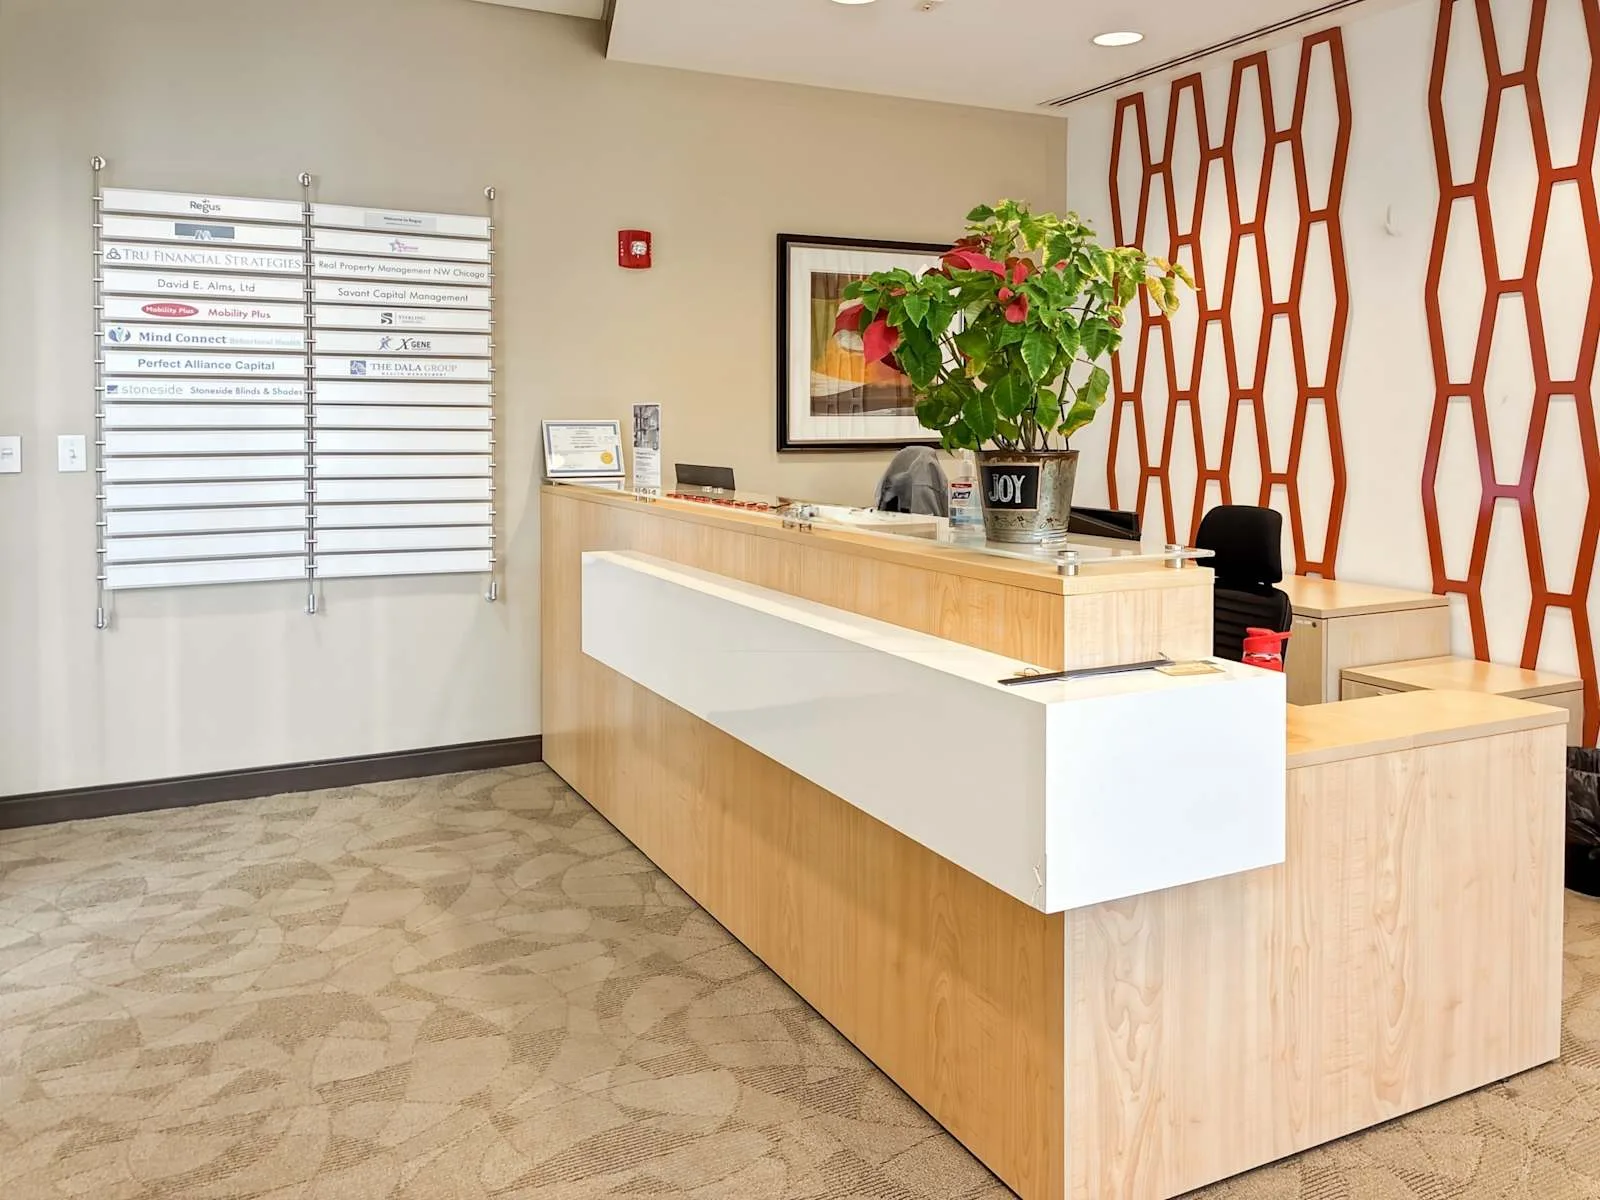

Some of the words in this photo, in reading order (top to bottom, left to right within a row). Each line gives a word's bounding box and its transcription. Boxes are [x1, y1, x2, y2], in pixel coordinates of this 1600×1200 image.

[190, 201, 220, 213] Regus
[122, 248, 149, 260] TRU
[154, 250, 221, 265] FINANCIAL
[224, 254, 300, 269] STRATEGIES
[340, 262, 375, 272] Property
[378, 264, 430, 275] Management
[434, 267, 450, 275] NW
[453, 269, 485, 279] Chicago
[158, 279, 188, 289] David
[193, 281, 202, 289] E.
[208, 282, 235, 292] Alms,
[240, 283, 255, 292] Ltd
[338, 288, 369, 297] Savant
[373, 289, 406, 300] Capital
[410, 291, 468, 302] Management
[146, 305, 176, 314] Mobility
[208, 308, 248, 319] Mobility
[252, 310, 271, 319] Plus
[139, 332, 171, 342] Mind
[176, 333, 227, 344] Connect
[138, 358, 181, 369] Perfect
[184, 360, 232, 370] Alliance
[235, 361, 275, 372] Capital
[424, 364, 457, 372] GROUP
[122, 384, 183, 394] stoneside
[190, 386, 232, 395] Stoneside
[236, 386, 261, 395] Blinds
[272, 388, 302, 396] Shades
[988, 473, 1026, 504] JOY
